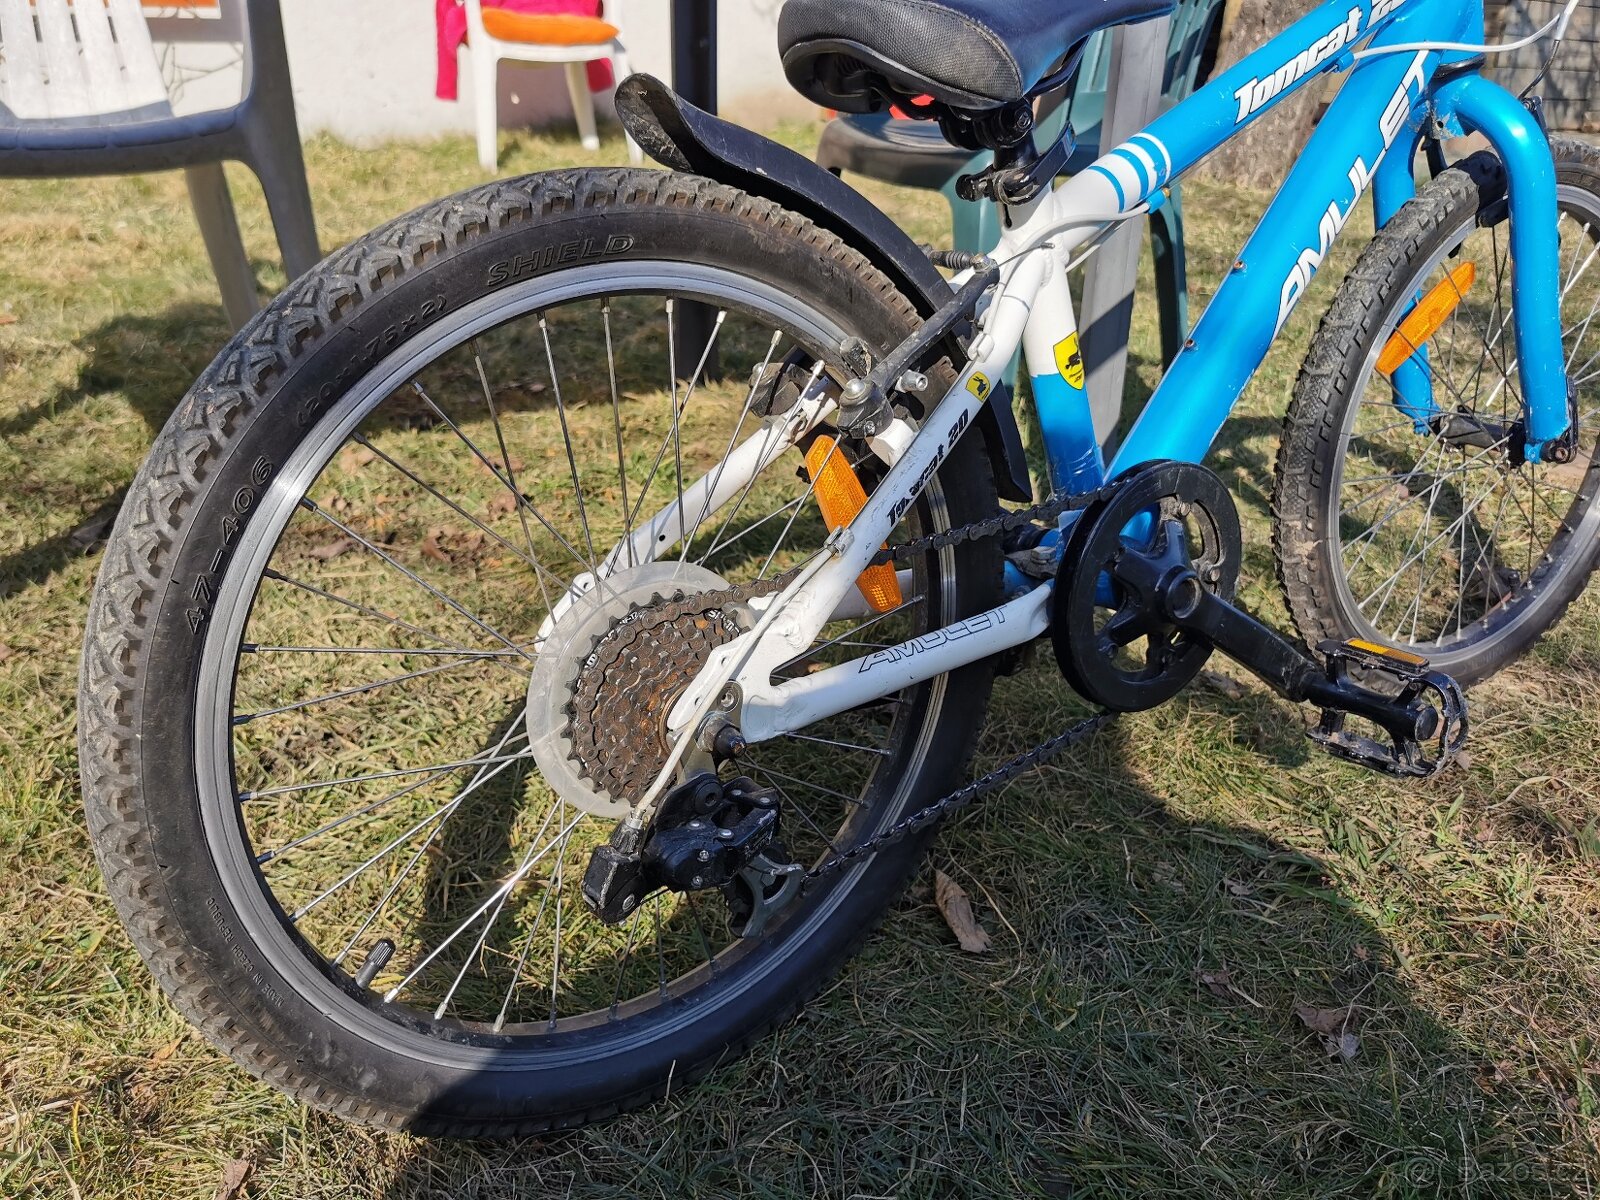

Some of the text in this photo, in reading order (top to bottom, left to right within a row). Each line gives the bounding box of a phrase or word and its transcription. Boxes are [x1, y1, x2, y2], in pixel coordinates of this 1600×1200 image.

[1233, 0, 1407, 125] Tomcat 2
[1270, 50, 1429, 347] AMULET
[487, 234, 635, 286] SHIELD
[947, 408, 969, 449] 20
[185, 456, 274, 635] 47-406
[858, 605, 1008, 673] AMULET
[206, 897, 285, 1007] MADE IN CZECH REPUBLIC
